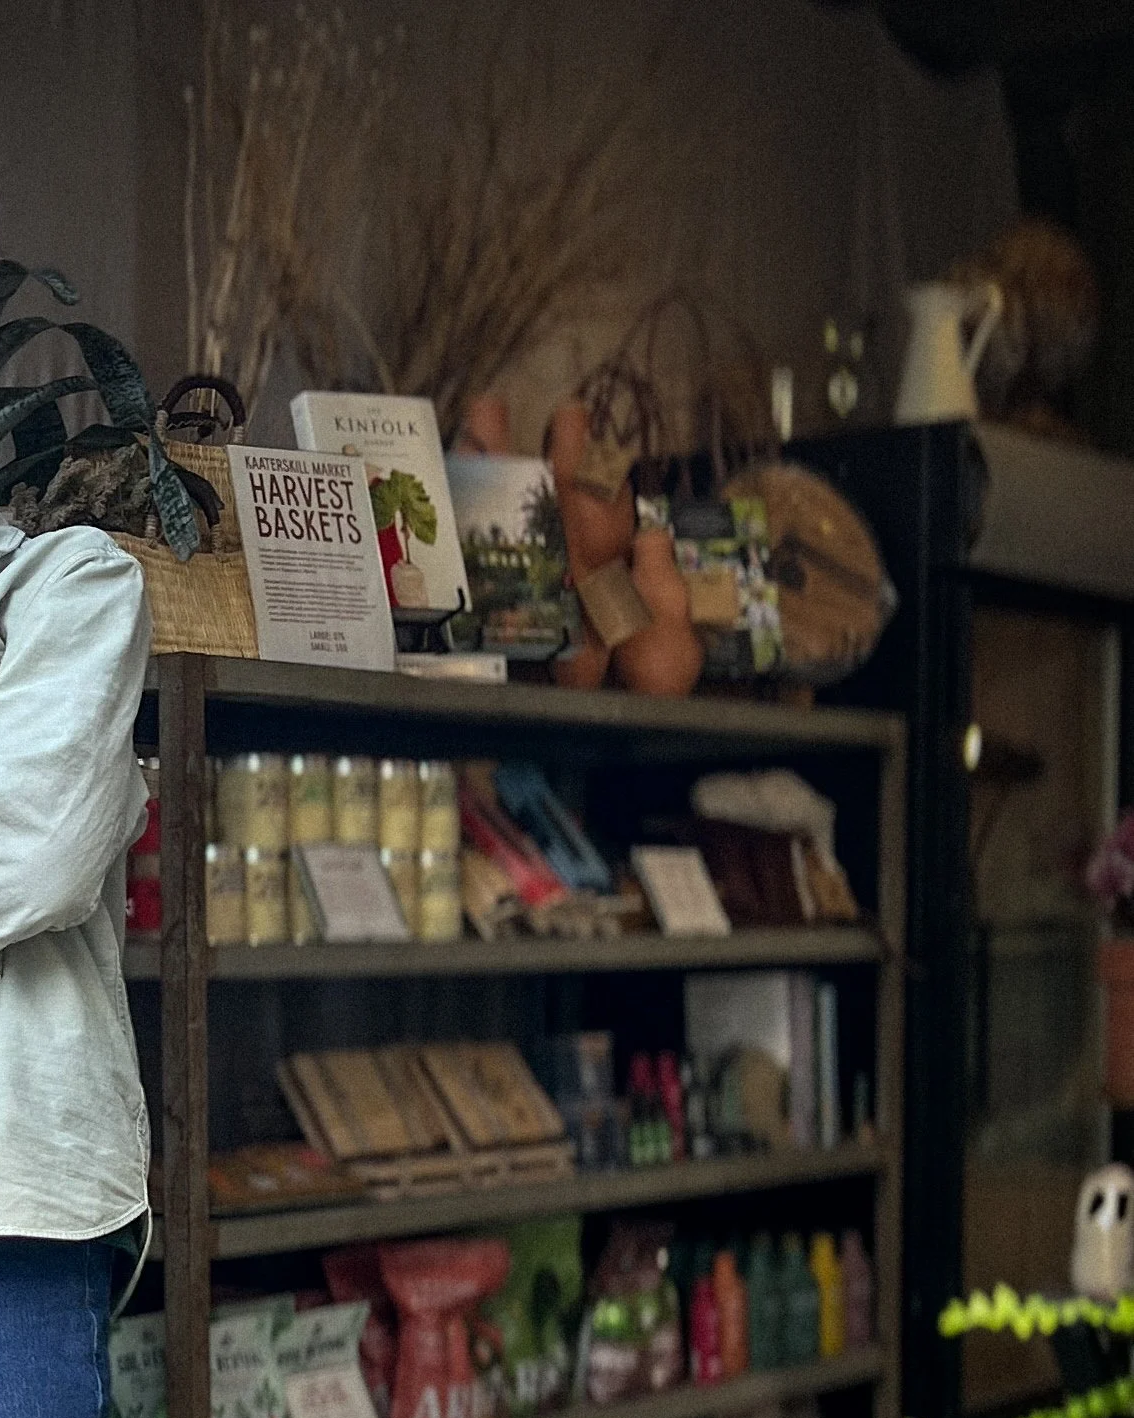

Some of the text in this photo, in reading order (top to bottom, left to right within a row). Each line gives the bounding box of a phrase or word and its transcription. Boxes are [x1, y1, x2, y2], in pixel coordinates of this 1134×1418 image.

[335, 416, 420, 437] KINFOLK
[245, 456, 352, 478] KAATERSKILL MARKET
[249, 472, 354, 511] HARVEST
[255, 506, 362, 544] BASKETS
